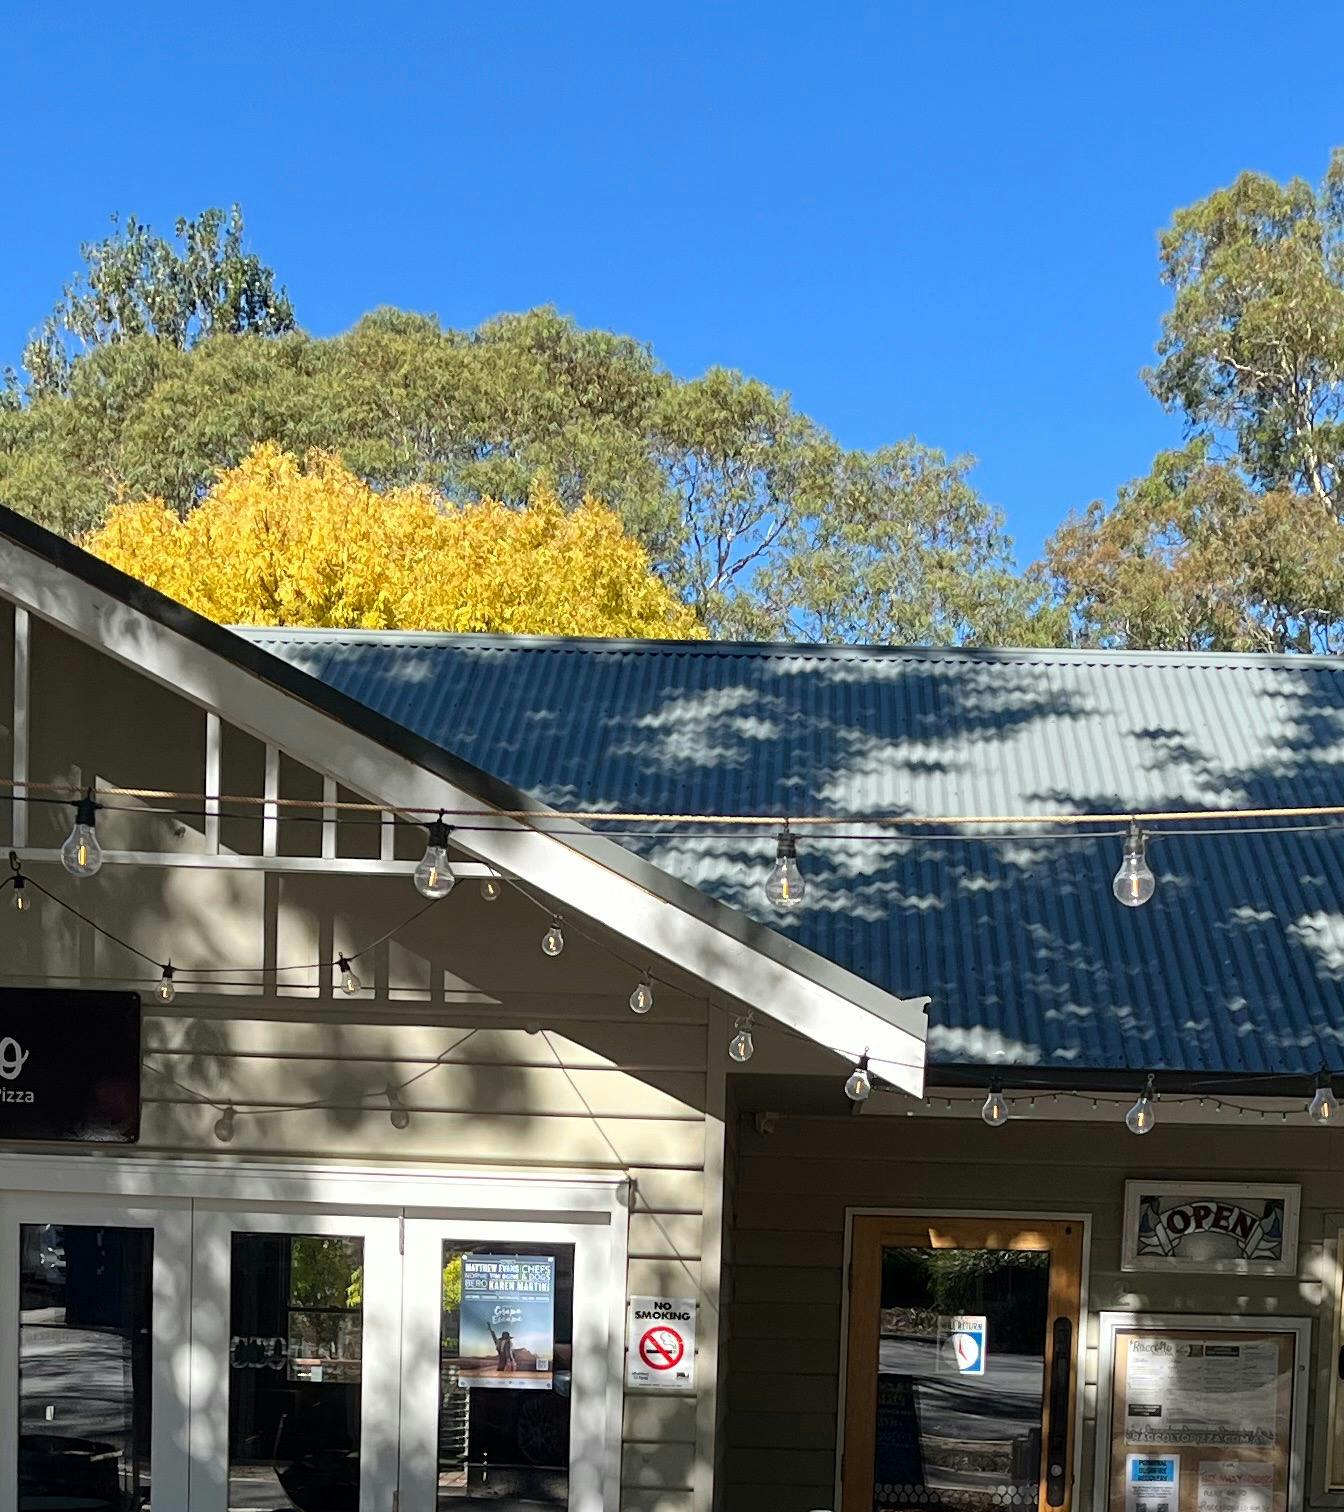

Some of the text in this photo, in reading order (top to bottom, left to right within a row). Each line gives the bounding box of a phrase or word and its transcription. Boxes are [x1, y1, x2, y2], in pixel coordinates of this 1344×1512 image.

[1167, 1205, 1257, 1241] OPEN
[465, 1263, 498, 1273] MATTHEW
[521, 1264, 551, 1274] CHEFS
[528, 1273, 551, 1281] DOGS
[488, 1280, 550, 1292] KAREN MARTINI
[654, 1301, 672, 1311] NO
[635, 1311, 691, 1321] SMOKING
